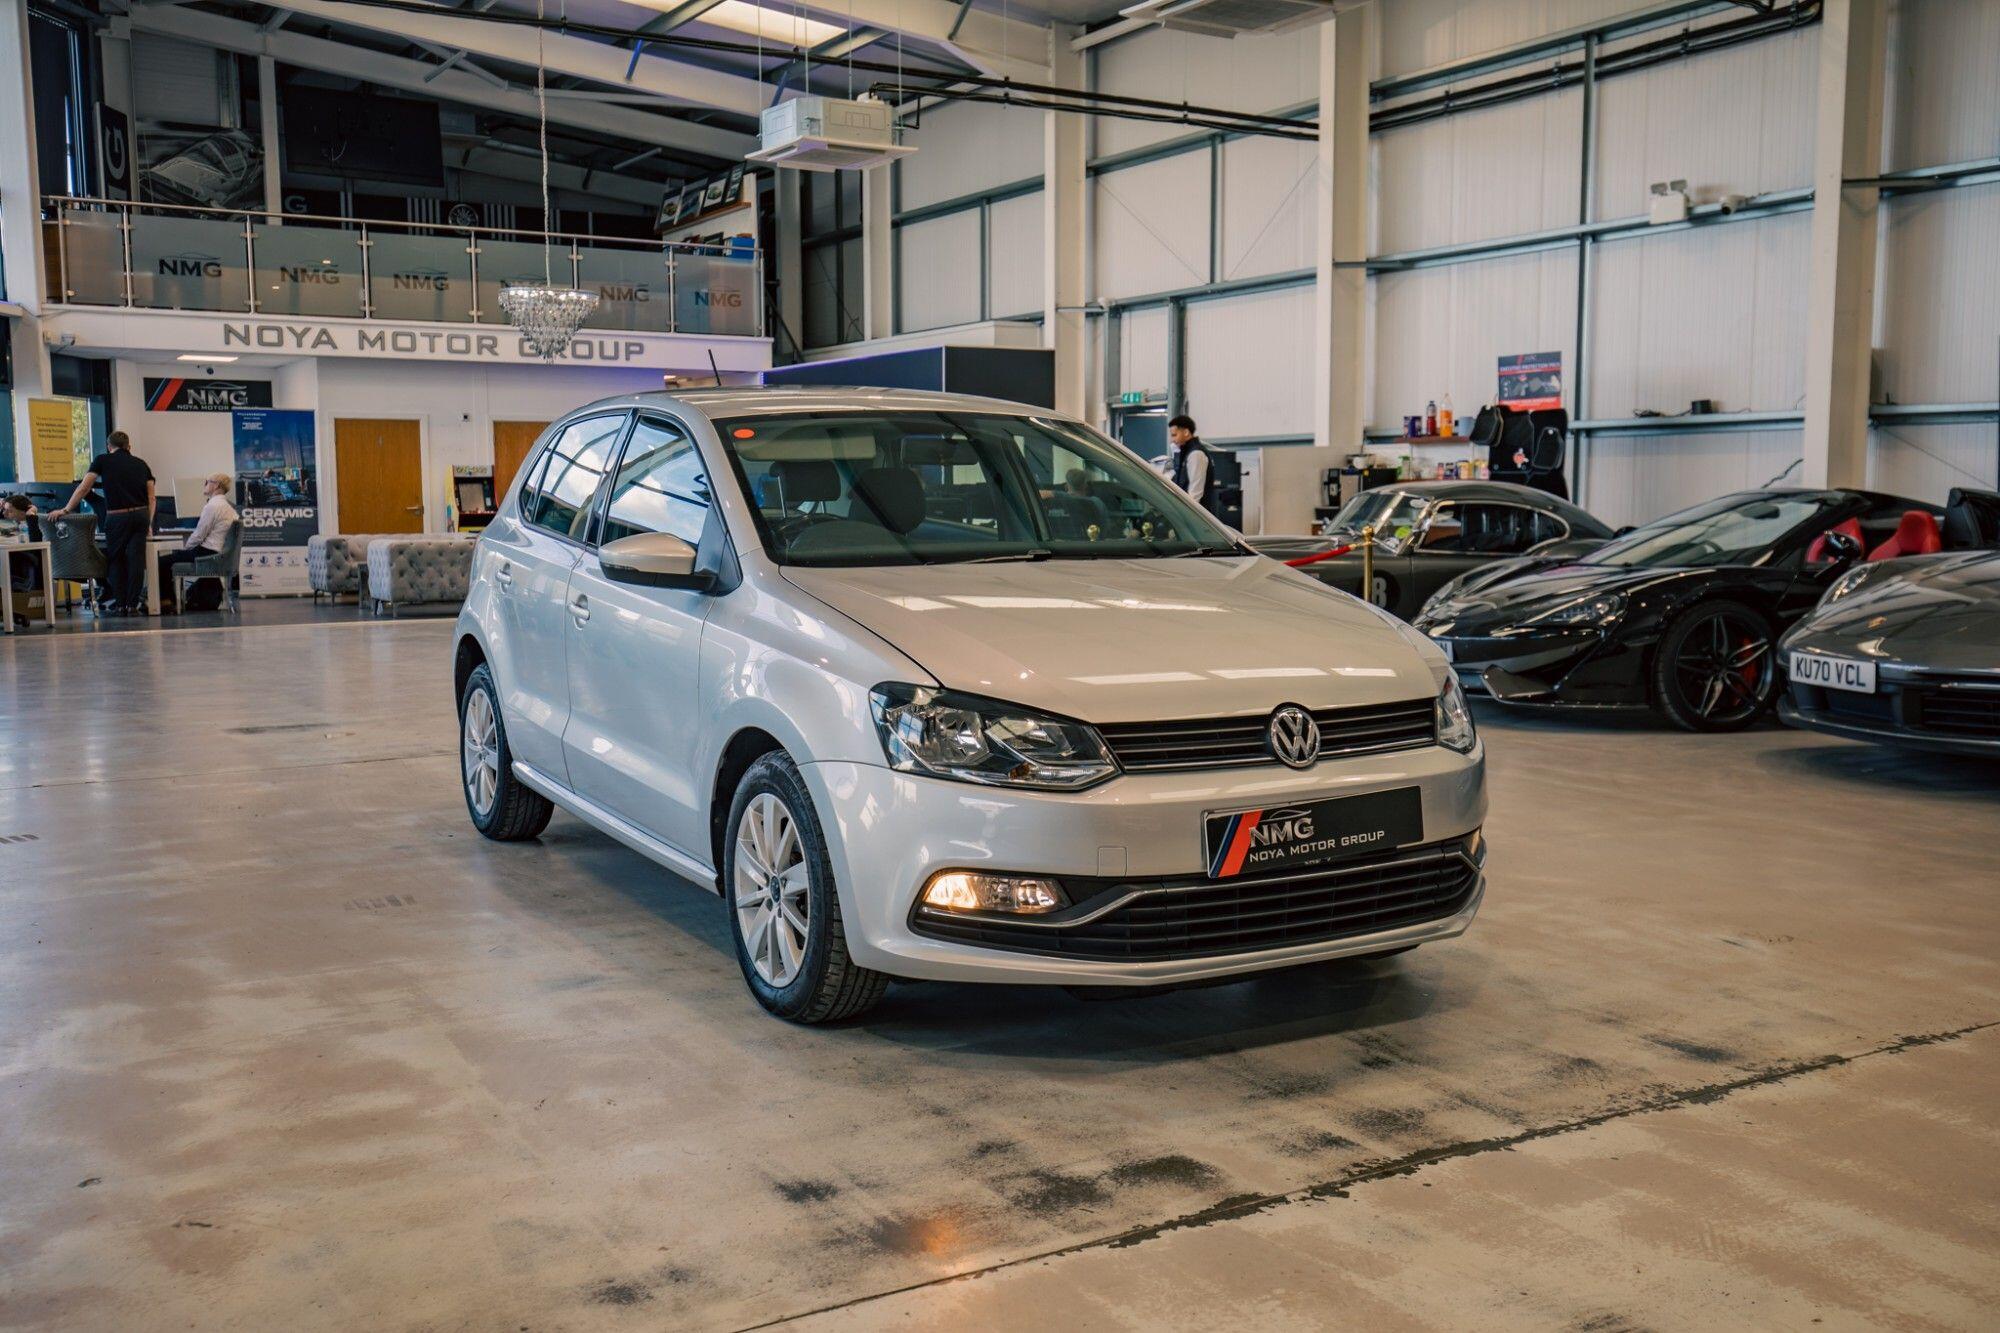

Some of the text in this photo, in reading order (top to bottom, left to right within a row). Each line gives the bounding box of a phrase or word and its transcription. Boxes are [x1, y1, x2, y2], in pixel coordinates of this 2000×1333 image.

[159, 258, 222, 277] NMG
[280, 267, 340, 284] NMG
[393, 273, 449, 291] NMG
[600, 286, 650, 302] NMG
[694, 291, 742, 308] NMG
[223, 323, 645, 361] NOYA MOTOR GOUP
[186, 389, 249, 406] NMG
[241, 508, 314, 518] CERAMIC
[243, 518, 286, 528] COAT
[1796, 656, 1867, 688] KU70 VCL
[1248, 817, 1315, 848] NMG
[1249, 849, 1285, 863] NOYA
[1290, 840, 1336, 856] MOTOR
[1341, 831, 1386, 847] GROUP
